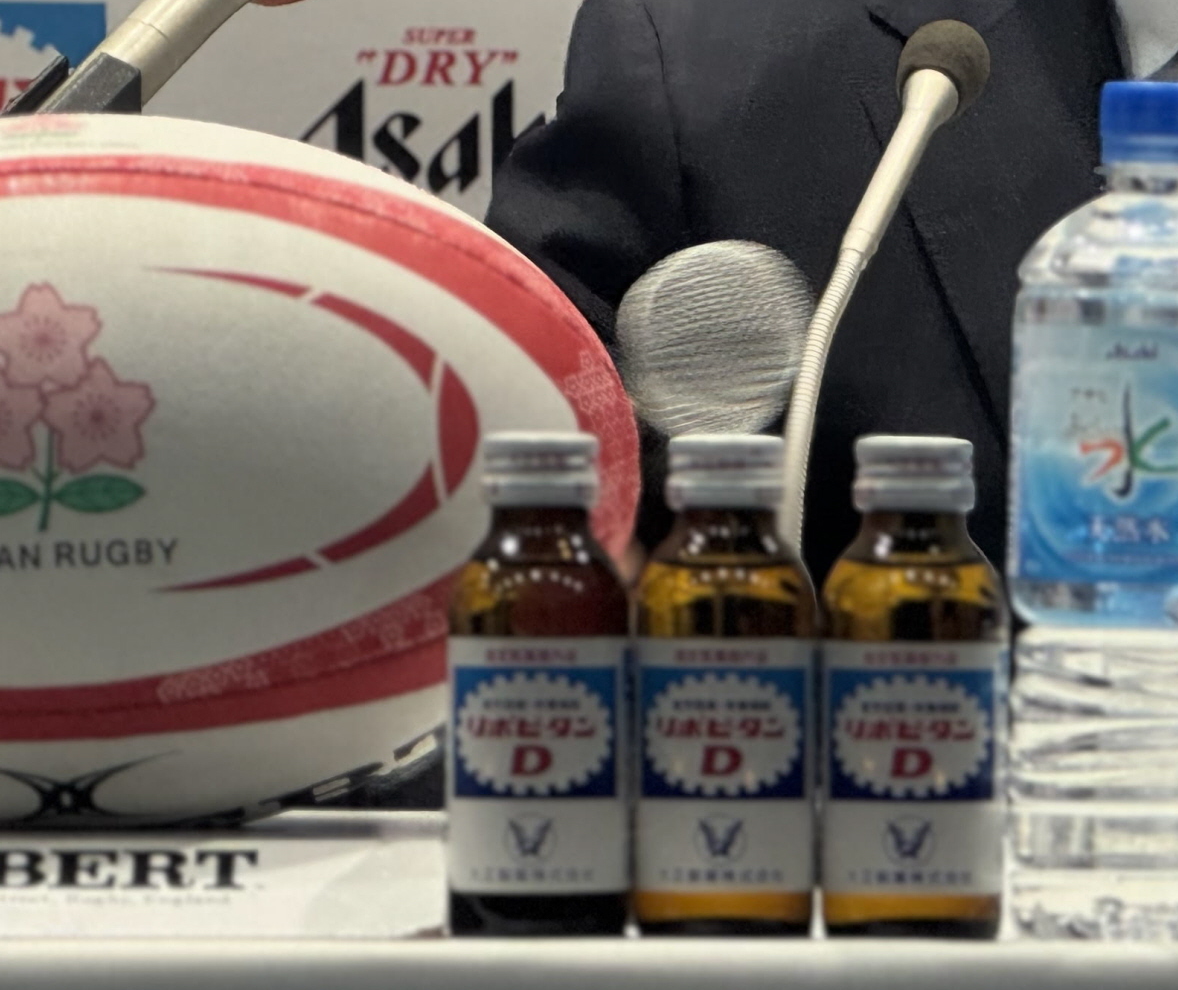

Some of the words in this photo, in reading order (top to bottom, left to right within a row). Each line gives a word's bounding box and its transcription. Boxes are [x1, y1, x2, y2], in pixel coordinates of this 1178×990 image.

[403, 28, 476, 44] SUPER
[55, 538, 178, 568] RUGBY
[511, 745, 553, 776] D
[702, 745, 743, 776] D
[891, 748, 933, 779] D
